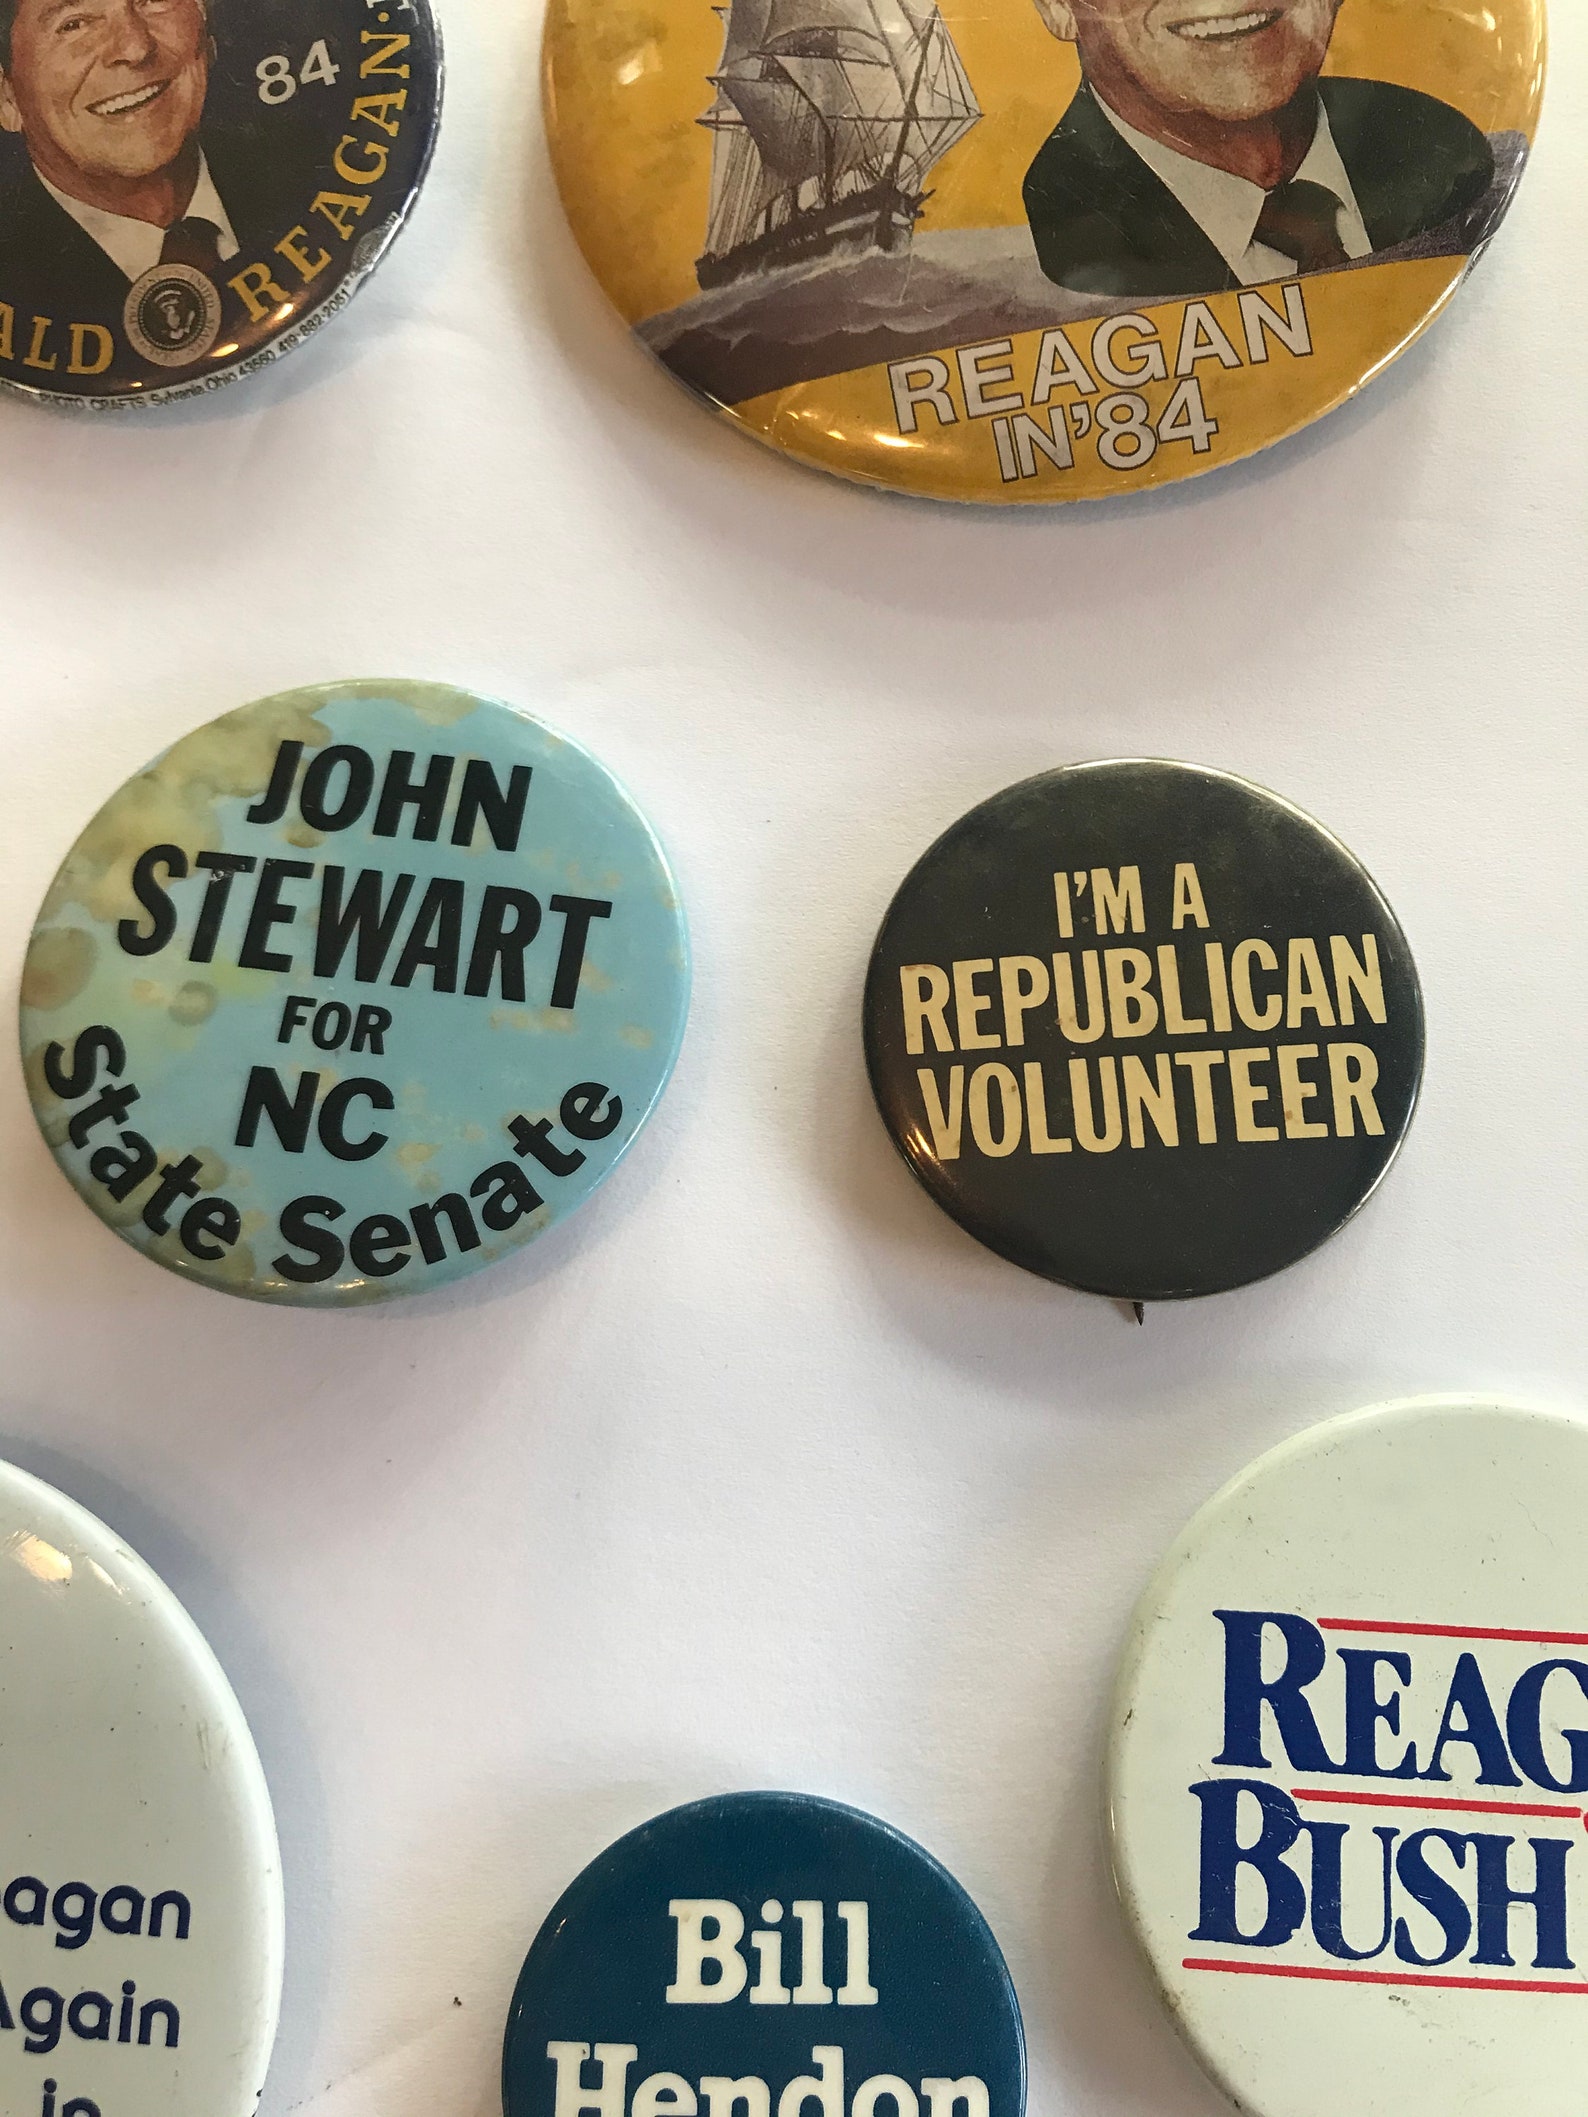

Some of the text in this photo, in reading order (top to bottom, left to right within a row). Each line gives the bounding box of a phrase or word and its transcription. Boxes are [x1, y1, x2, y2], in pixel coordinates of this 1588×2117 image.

[254, 38, 341, 105] 84
[887, 283, 1314, 435] REAGAN
[246, 740, 534, 852] JOHN
[117, 844, 613, 1010] STEWART
[1053, 862, 1211, 939] I'M A
[277, 995, 393, 1055] FOR
[899, 933, 1388, 1056] REPUBLICAN
[44, 1024, 624, 1284] State Senate
[234, 1065, 395, 1161] NC
[916, 1042, 1386, 1161] VOLUNTEER
[1211, 1609, 1588, 1795] REAG
[0, 1876, 192, 1950] agan
[1187, 1778, 1577, 1970] BUSH
[665, 1898, 880, 2006] Bill
